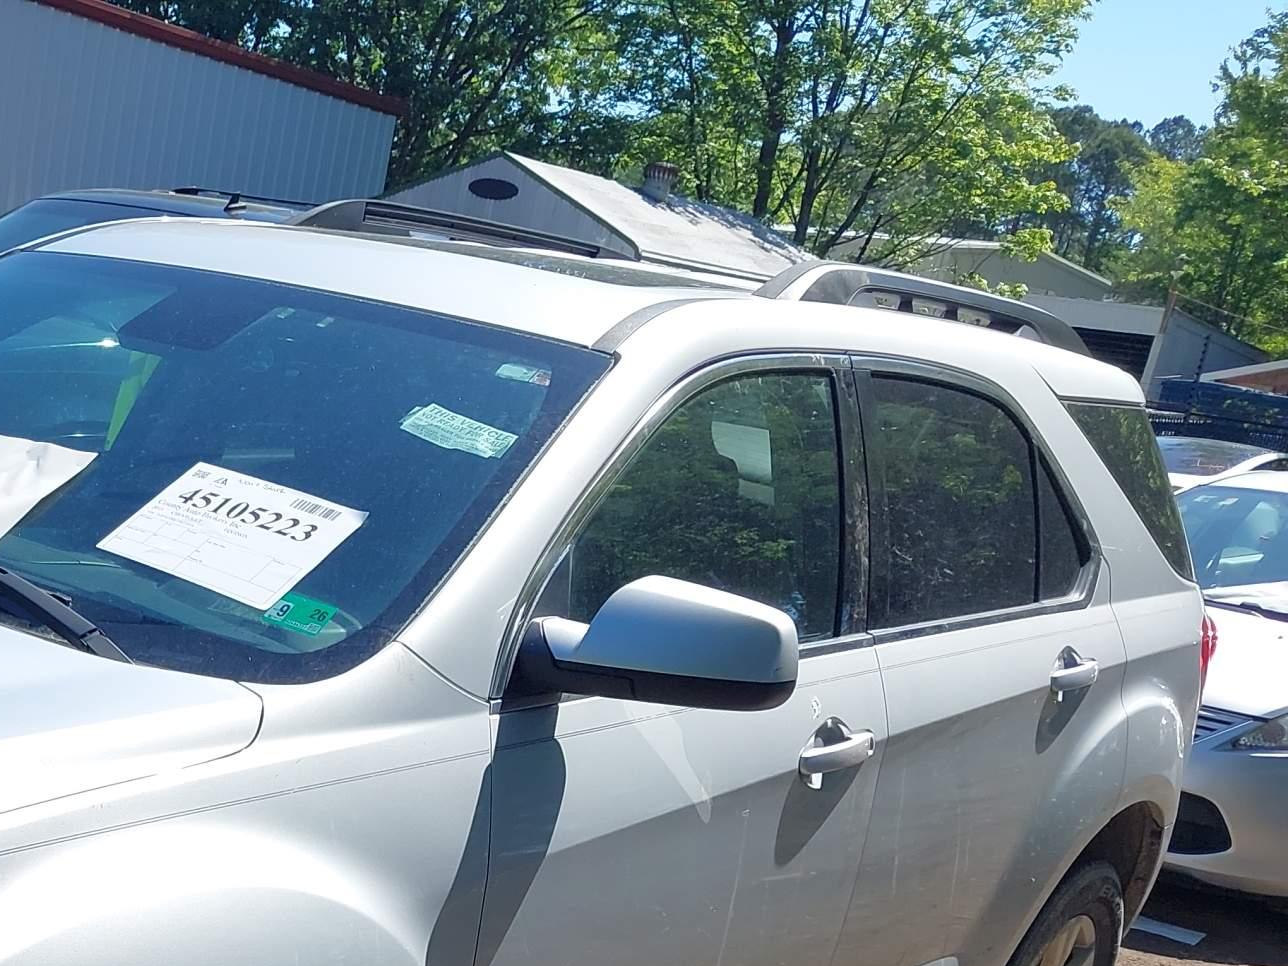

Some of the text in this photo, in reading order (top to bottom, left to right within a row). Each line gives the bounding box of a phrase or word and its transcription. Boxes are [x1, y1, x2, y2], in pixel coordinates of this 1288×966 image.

[429, 406, 457, 421] THIS
[460, 419, 513, 442] VEHICLE
[438, 418, 467, 432] READY
[178, 488, 318, 541] 45105223
[276, 603, 290, 617] 9
[310, 608, 329, 622] 26
